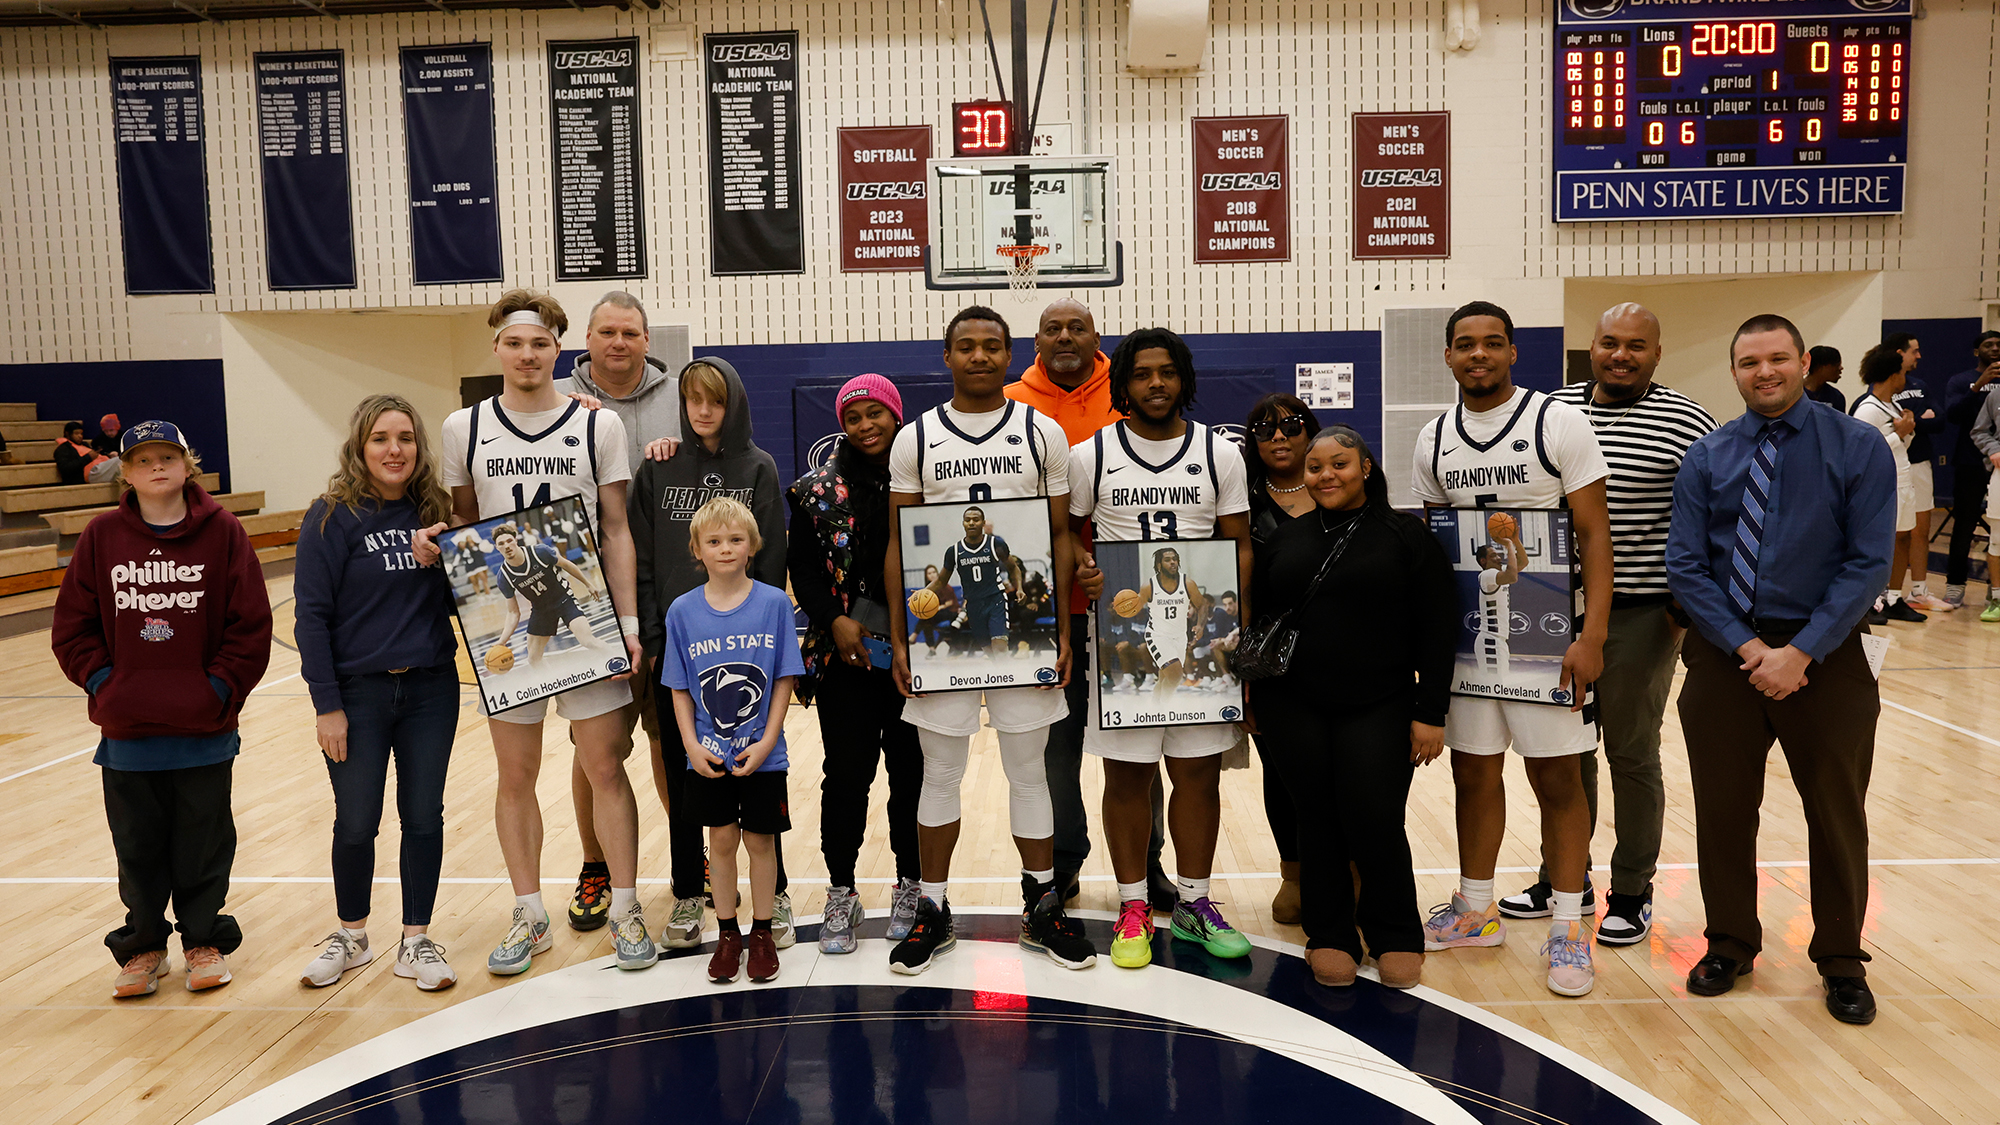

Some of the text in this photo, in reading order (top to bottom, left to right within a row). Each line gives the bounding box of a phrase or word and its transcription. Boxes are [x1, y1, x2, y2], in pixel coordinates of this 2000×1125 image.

[1643, 27, 1675, 42] Lions
[1787, 24, 1828, 38] Guests
[1843, 25, 1900, 38] plyr pts fls
[1567, 33, 1622, 45] plyr pts fls
[1692, 23, 1776, 55] 20:00
[712, 42, 791, 63] USCAA
[1811, 41, 1829, 73] 0
[1844, 43, 1901, 58] 00 0 0
[424, 55, 467, 64] VOLLEYBALL
[555, 48, 632, 69] USCAA
[1567, 51, 1624, 65] 00 0 0
[1662, 45, 1681, 77] 0
[145, 67, 189, 76] BASKETBALL
[259, 61, 338, 71] WOMEN'S BASKETBALL
[443, 68, 474, 78] ASSISTS
[727, 66, 776, 79] NATIONAL
[1843, 59, 1901, 74] 05 0 0
[306, 75, 338, 84] SCORERS
[570, 72, 618, 85] NATIONAL
[1567, 67, 1624, 81] 05 0 0
[1772, 70, 1778, 91] 1
[163, 81, 195, 90] SCORERS
[712, 80, 793, 94] ACADEMIC TEAM
[1713, 75, 1751, 92] period
[1847, 75, 1900, 89] 14 0 0
[554, 86, 634, 100] ACADEMIC TEAM
[1571, 83, 1623, 96] 11 0 0
[1571, 98, 1623, 112] 13 0 0
[1798, 97, 1825, 111] fouls
[1843, 91, 1900, 105] 33 0 0
[1640, 101, 1667, 114] fouls
[1713, 98, 1751, 114] player
[1571, 114, 1623, 128] 14 0 0
[1842, 107, 1899, 121] 35 0 0
[961, 109, 1006, 148] 30
[1222, 129, 1259, 142] MEN'S
[1382, 125, 1420, 138] MEN'S
[1649, 122, 1663, 145] 0
[1681, 121, 1695, 144] 6
[1769, 119, 1783, 142] 6
[1806, 118, 1821, 142] 0
[853, 149, 917, 163] SOFTBALL
[1217, 147, 1264, 159] SOCCER
[1378, 143, 1425, 155] SOCCER
[1799, 150, 1821, 161] won
[1642, 154, 1664, 164] won
[1716, 152, 1746, 165] game
[1201, 172, 1281, 191] USCAA
[1361, 168, 1442, 187] USCAA
[453, 182, 471, 191] DIGS
[846, 181, 926, 200] USCAA
[1572, 176, 1891, 209] PENN STATE LIVES HERE
[1226, 201, 1257, 215] 2018
[1386, 197, 1417, 211] 2021
[869, 210, 904, 224] 2023
[1373, 216, 1429, 229] NATIONAL
[1213, 219, 1270, 233] NATIONAL
[859, 228, 915, 242] NATIONAL
[1368, 233, 1435, 246] CHAMPIONS
[1208, 237, 1276, 250] CHAMPIONS
[854, 245, 921, 259] CHAMPIONS
[842, 389, 869, 404] MACKAGE
[486, 456, 576, 477] BRANDYWINE
[935, 456, 1022, 481] BRANDYWINE
[1445, 464, 1529, 490] BRANDYWINE
[1112, 486, 1201, 506] BRANDYWINE
[1137, 510, 1178, 540] 13
[364, 529, 417, 552] NITT
[383, 552, 441, 570] LIO
[960, 555, 991, 566] BRANDYWINE
[111, 560, 205, 593] phillies
[972, 565, 982, 582] 0
[530, 581, 547, 596] 14
[115, 587, 205, 617] phever
[1164, 606, 1177, 619] 13
[140, 628, 174, 637] SERIES
[913, 673, 1014, 690] 0 Devon Jones
[489, 668, 597, 710] 14 Colin Hockenbrock
[1459, 680, 1540, 698] Ahmen Cleveland
[1104, 710, 1206, 726] 13 Johnta Dunson
